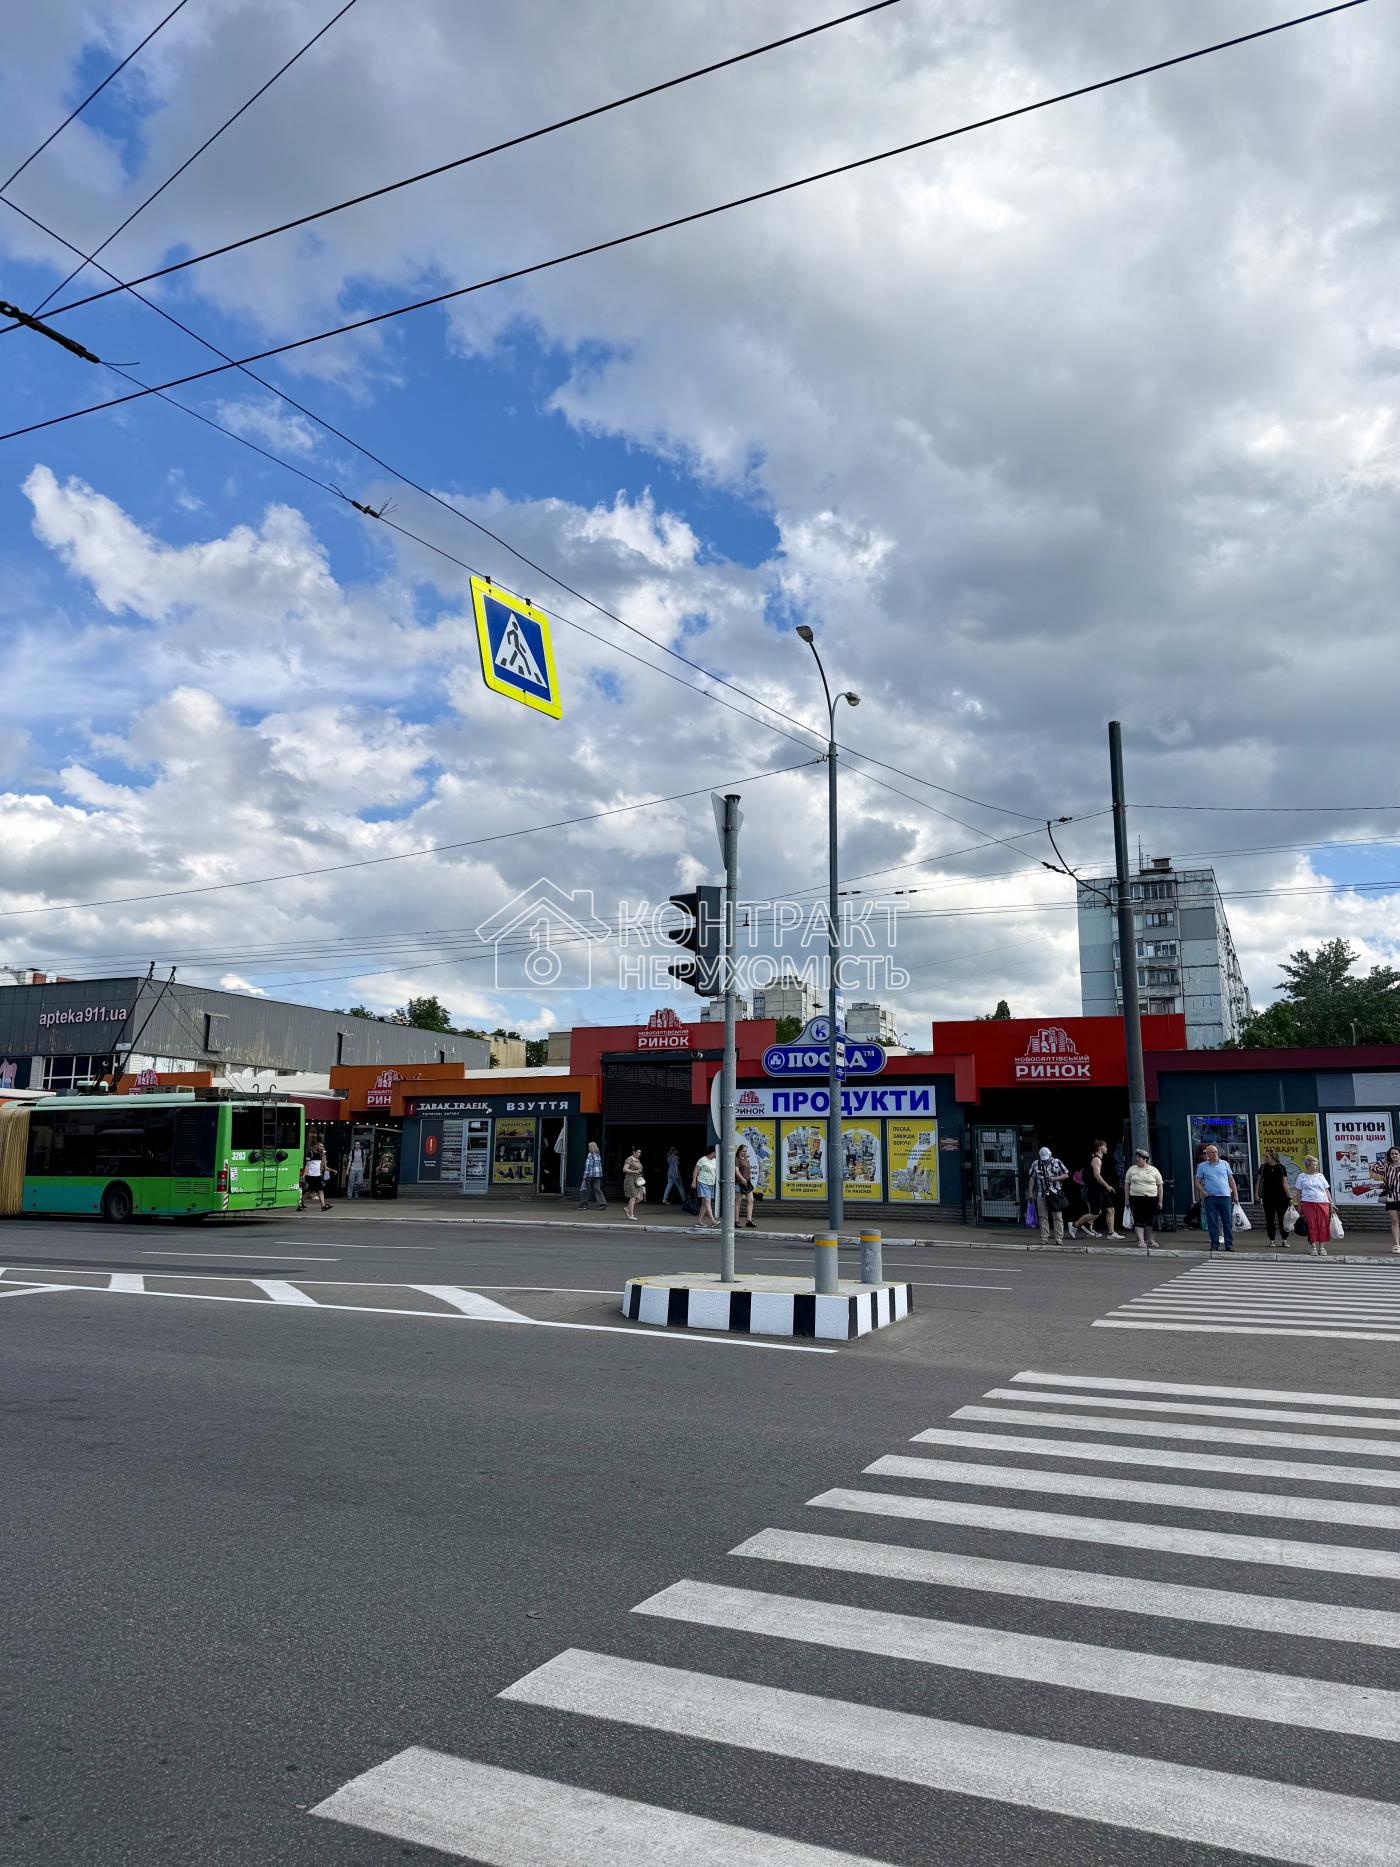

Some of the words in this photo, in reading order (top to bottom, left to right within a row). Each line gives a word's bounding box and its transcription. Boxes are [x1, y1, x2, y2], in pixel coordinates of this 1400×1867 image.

[39, 1006, 127, 1028] apteka911.ua
[638, 1036, 689, 1048] РИНОК
[787, 1050, 868, 1068] ПОСД
[1015, 1065, 1092, 1077] РИНОК
[367, 1095, 392, 1105] РИН
[772, 1090, 930, 1115] ПРОДУКТИ
[419, 1102, 450, 1111] TABAK
[453, 1101, 489, 1110] TRAFIK
[506, 1101, 569, 1111] ВЗУТТЯ
[1262, 1118, 1314, 1128] БАТАРЕЙКИ
[1334, 1122, 1386, 1132] ТЮТЮН
[1262, 1128, 1295, 1136] ЛАМПИ
[1263, 1137, 1316, 1146] ГОСПОДАРСЬКІ
[1366, 1134, 1386, 1142] ЦІНИ
